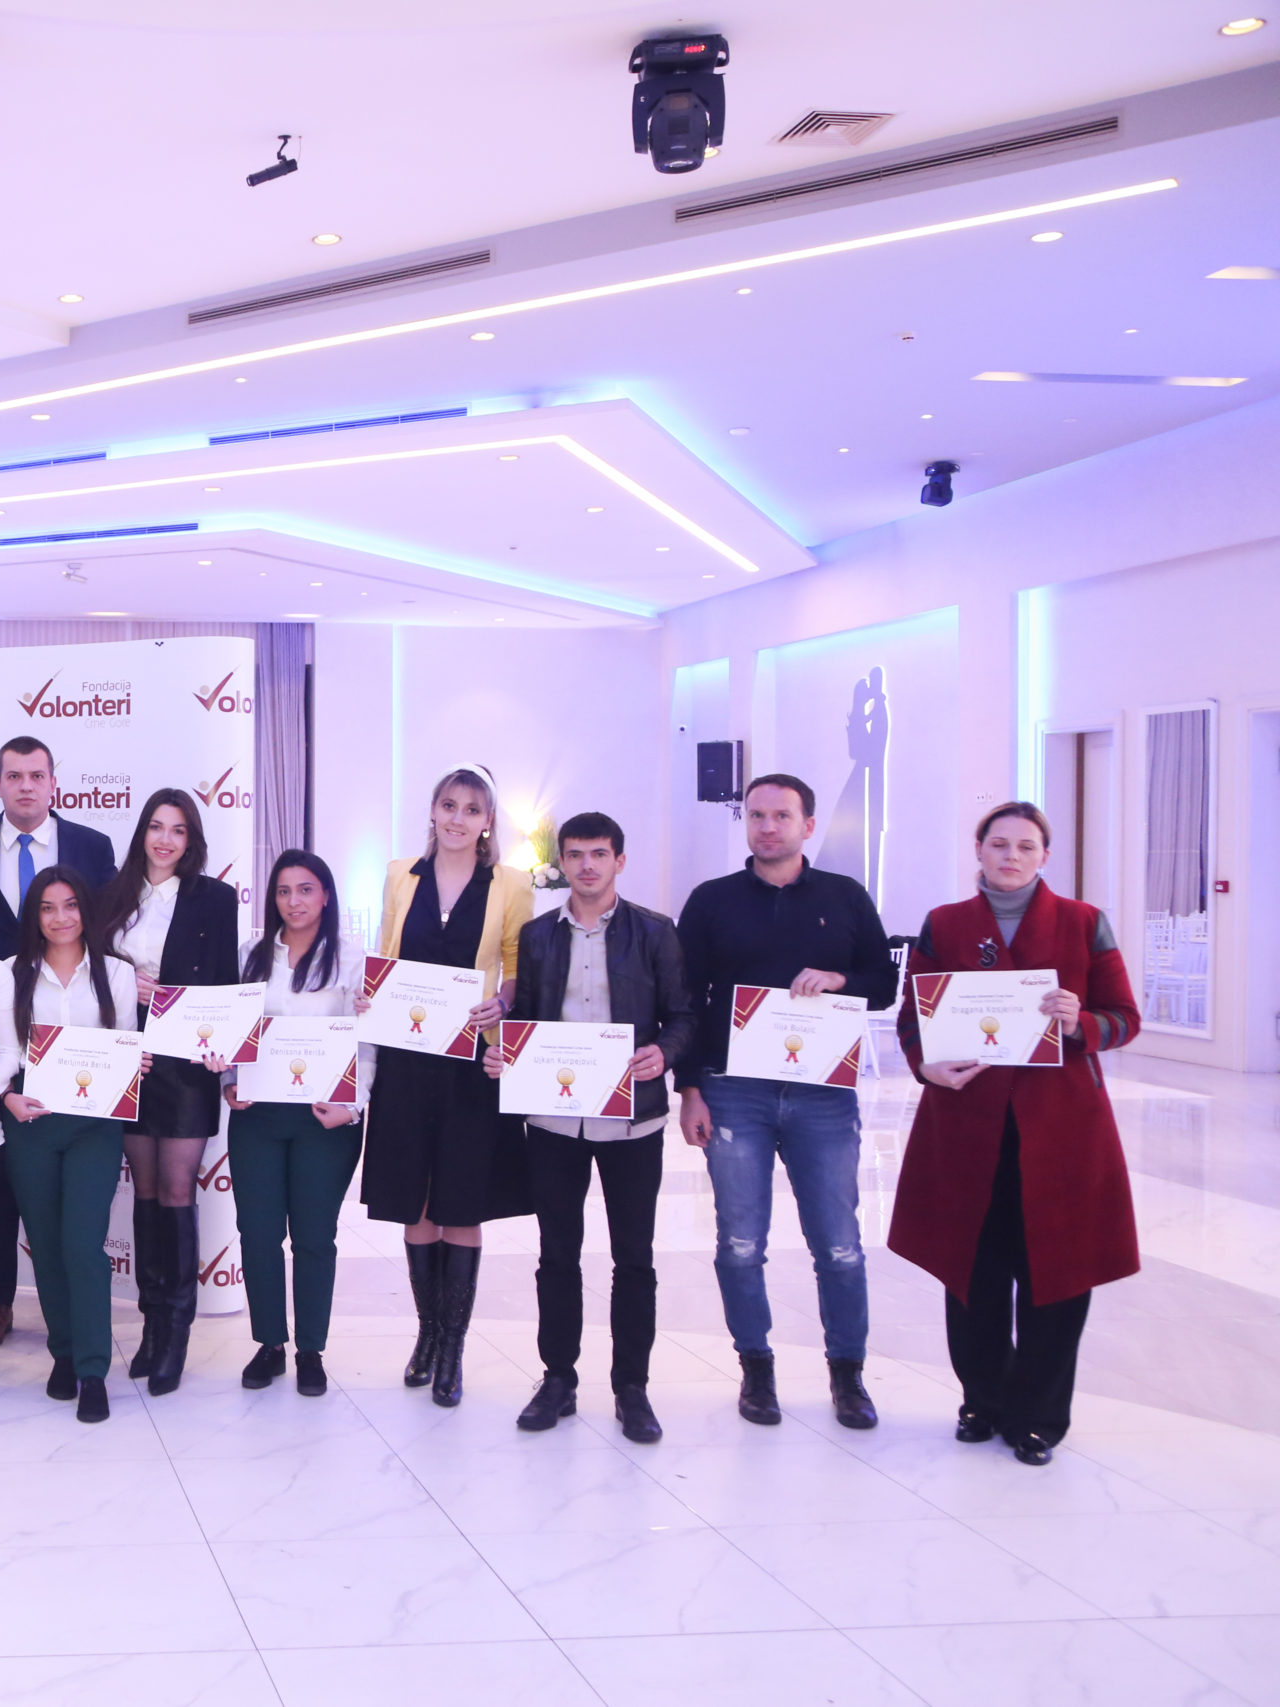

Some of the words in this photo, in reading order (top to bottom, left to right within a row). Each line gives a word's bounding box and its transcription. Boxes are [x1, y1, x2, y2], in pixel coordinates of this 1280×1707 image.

[82, 680, 131, 693] Fondacija
[16, 670, 131, 718] Volonteri
[81, 773, 131, 786] Fondacija
